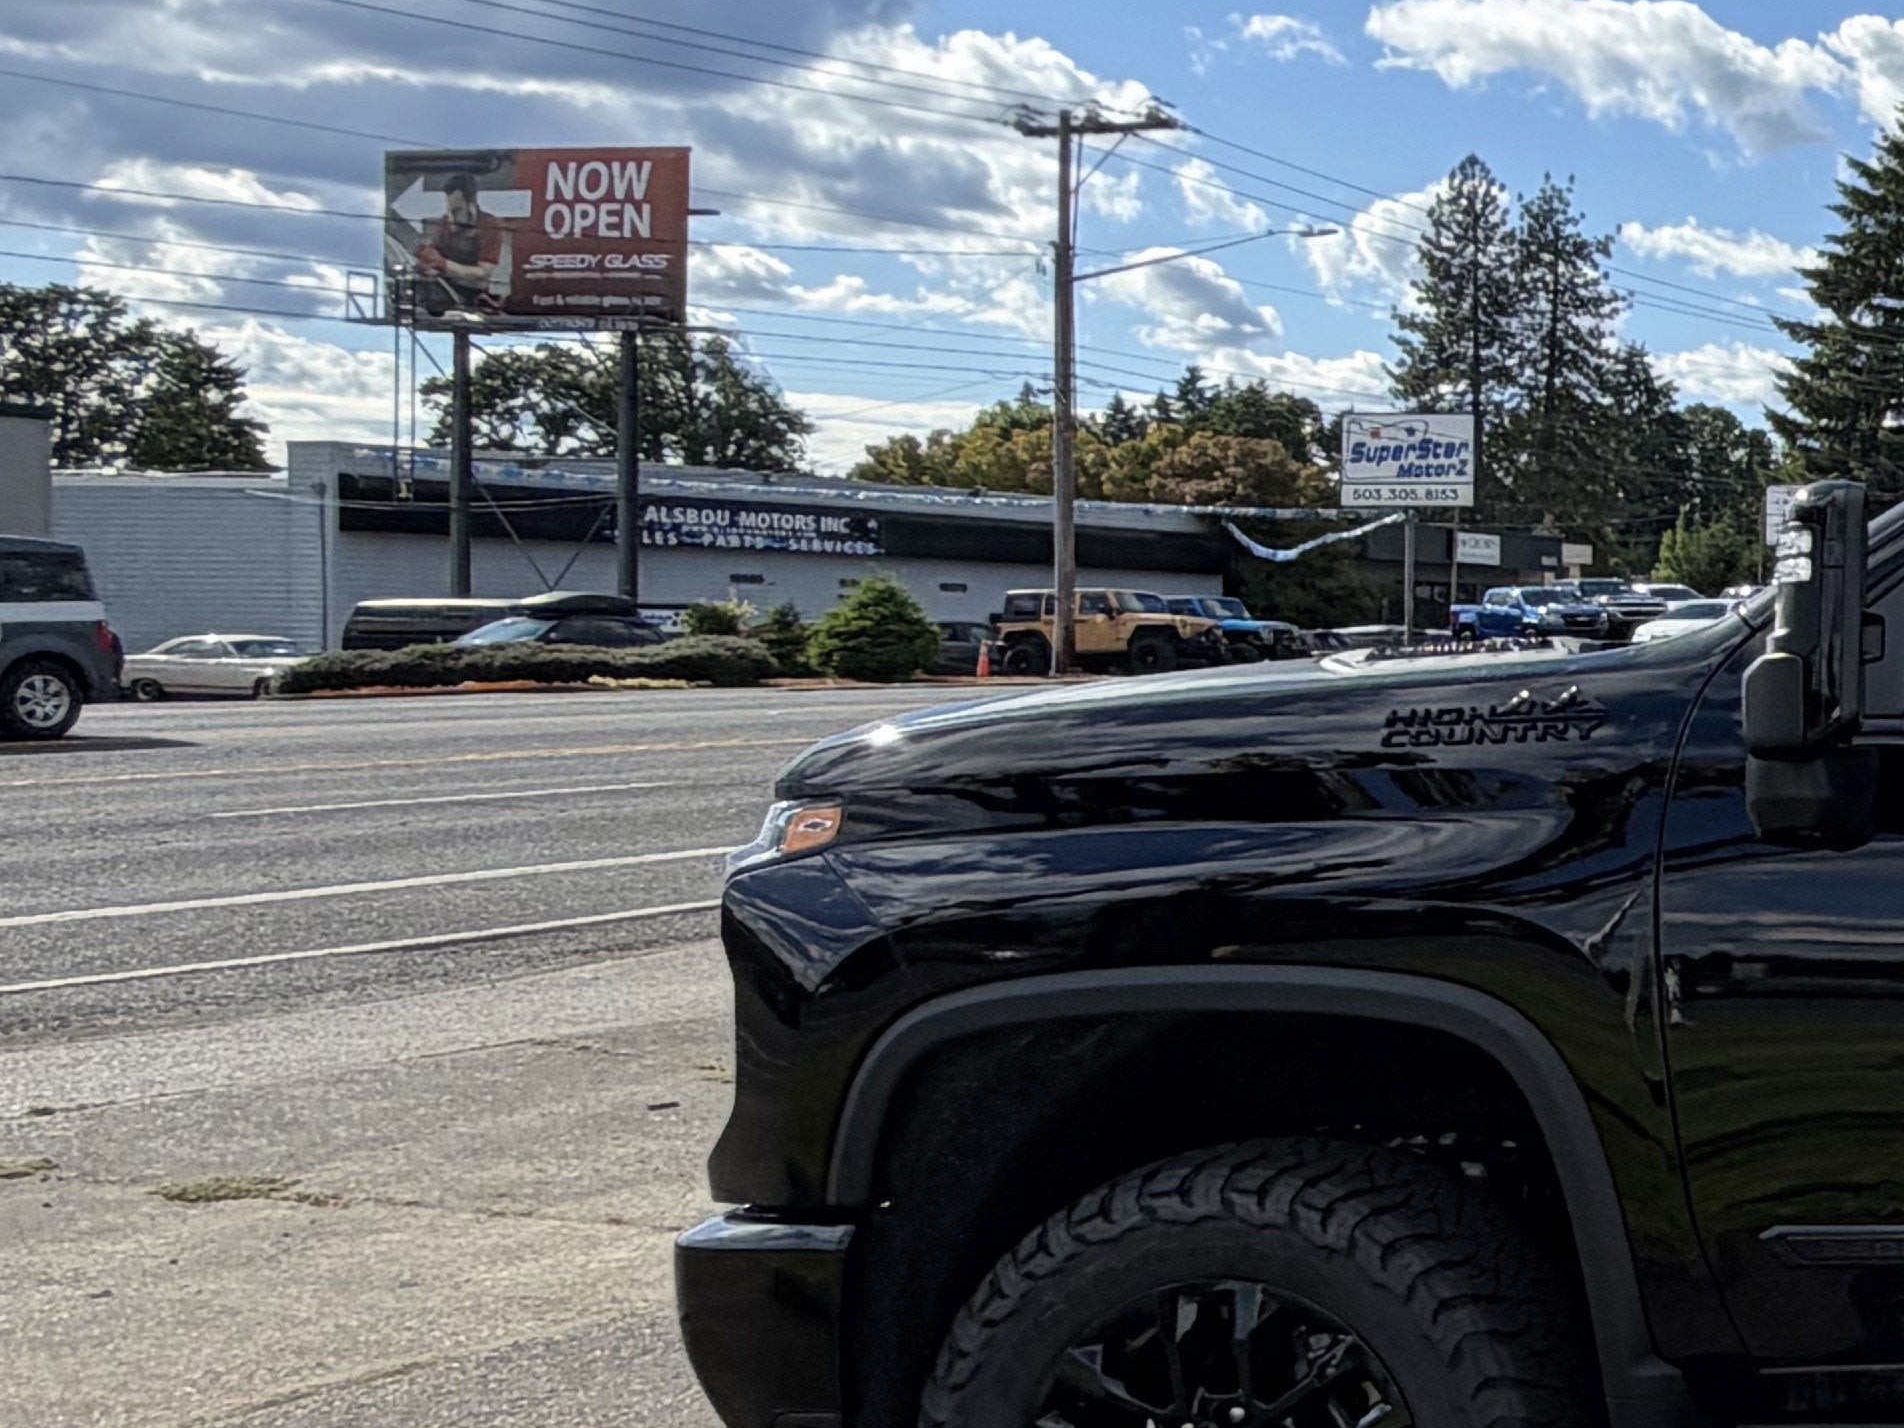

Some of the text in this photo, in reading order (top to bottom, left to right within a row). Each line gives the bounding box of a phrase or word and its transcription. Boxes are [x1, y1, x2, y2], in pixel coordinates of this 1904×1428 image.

[545, 160, 652, 201] NOW
[544, 202, 651, 239] OPEN
[522, 254, 674, 270] SPEEDY GLASS
[1349, 438, 1470, 468] SuperStar
[644, 505, 730, 525] ALSBOU
[738, 510, 817, 531] MOTORS
[1381, 720, 1606, 748] COUNTRY
